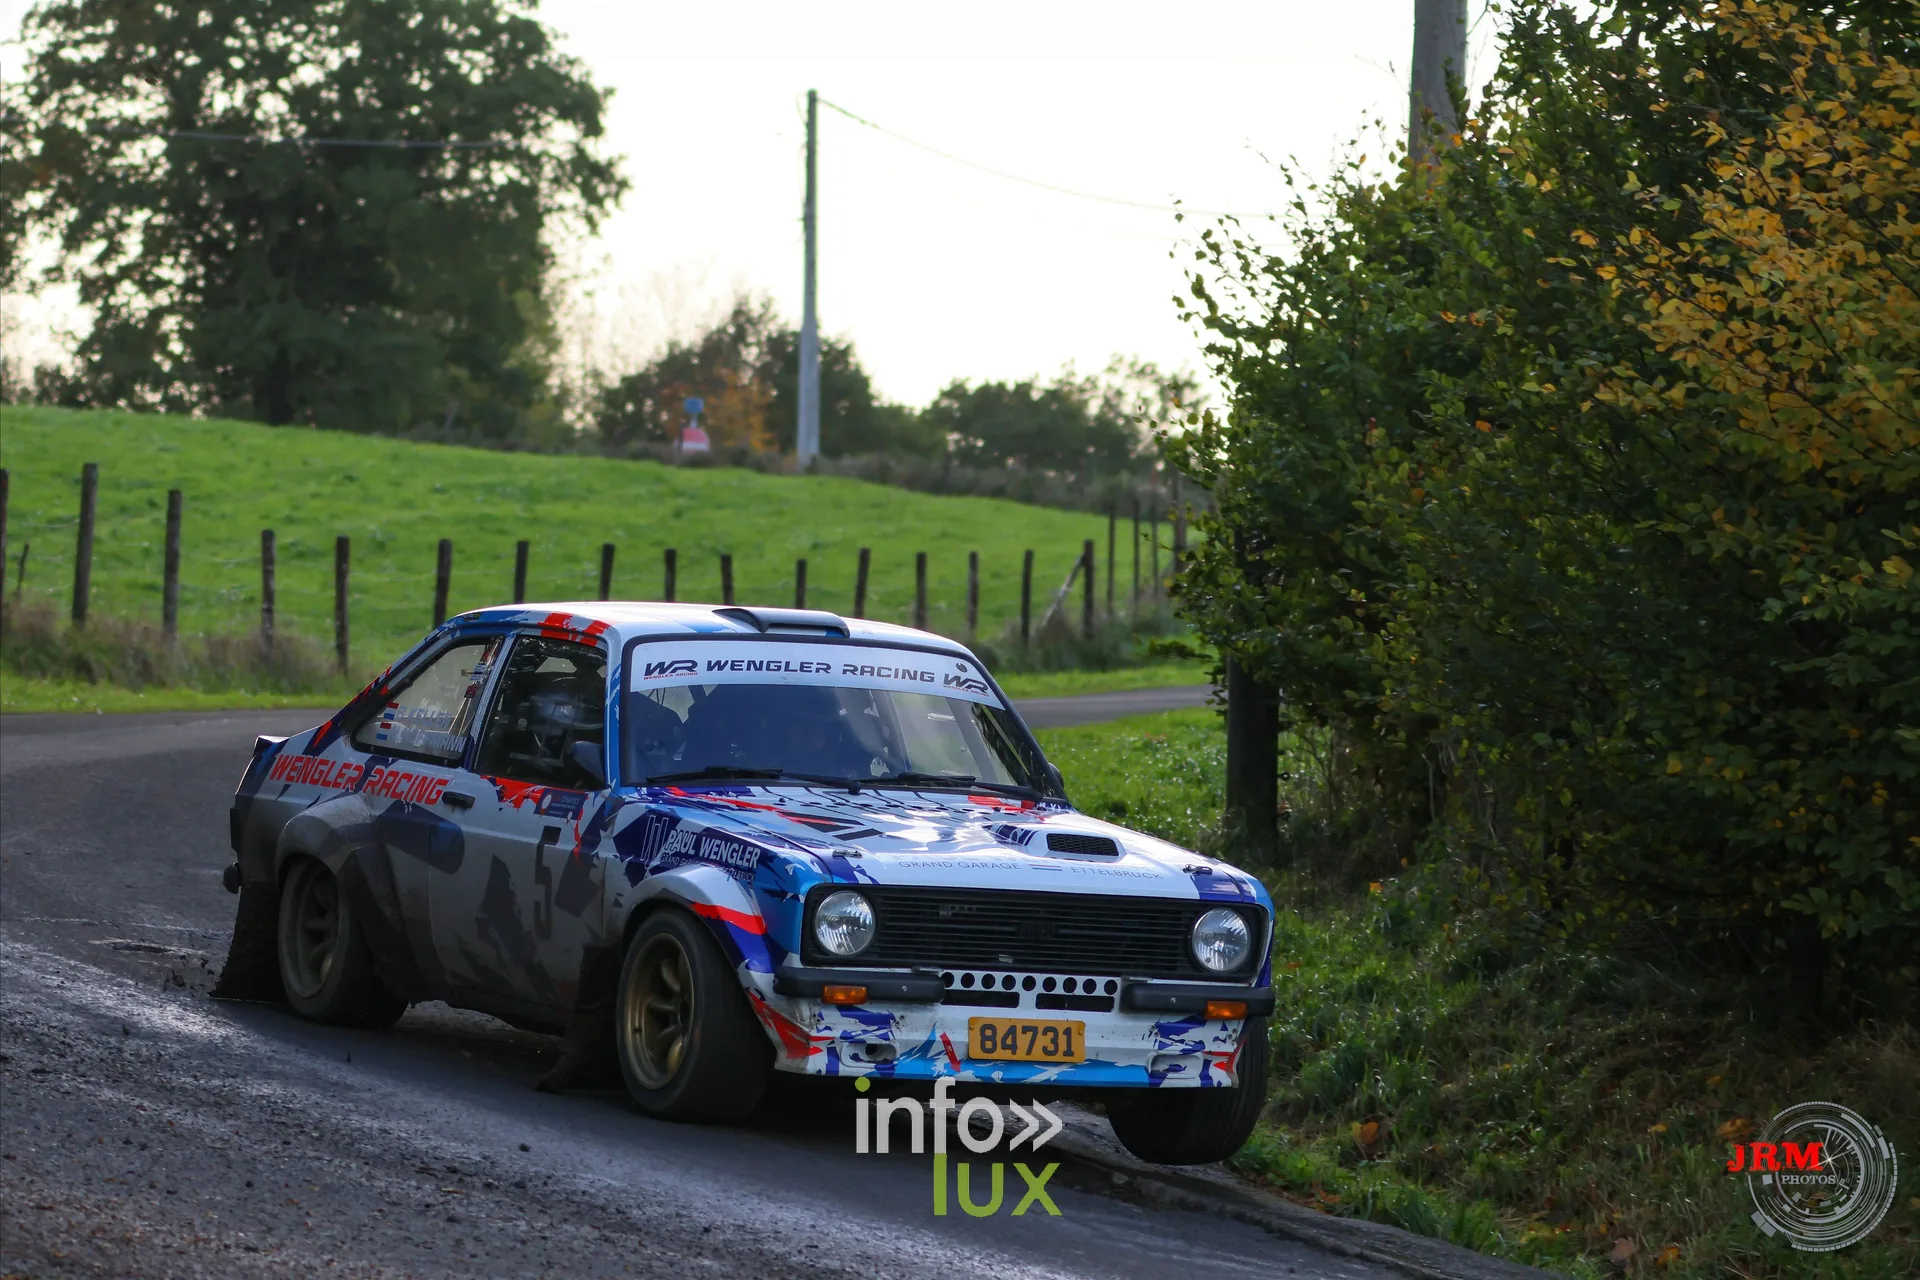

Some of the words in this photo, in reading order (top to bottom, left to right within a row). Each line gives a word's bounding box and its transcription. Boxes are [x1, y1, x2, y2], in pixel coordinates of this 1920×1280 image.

[706, 659, 832, 674] WENGLER
[842, 663, 935, 683] RACING
[269, 754, 364, 792] WENGLER
[362, 765, 450, 806] RACING
[664, 829, 698, 855] PAUL
[699, 836, 761, 869] WENGLER
[898, 860, 953, 869] GRAND
[957, 861, 1021, 871] GARAGE
[534, 825, 562, 941] 5
[1070, 866, 1164, 881] ETTELBRUCK
[980, 1023, 1075, 1058] 84731
